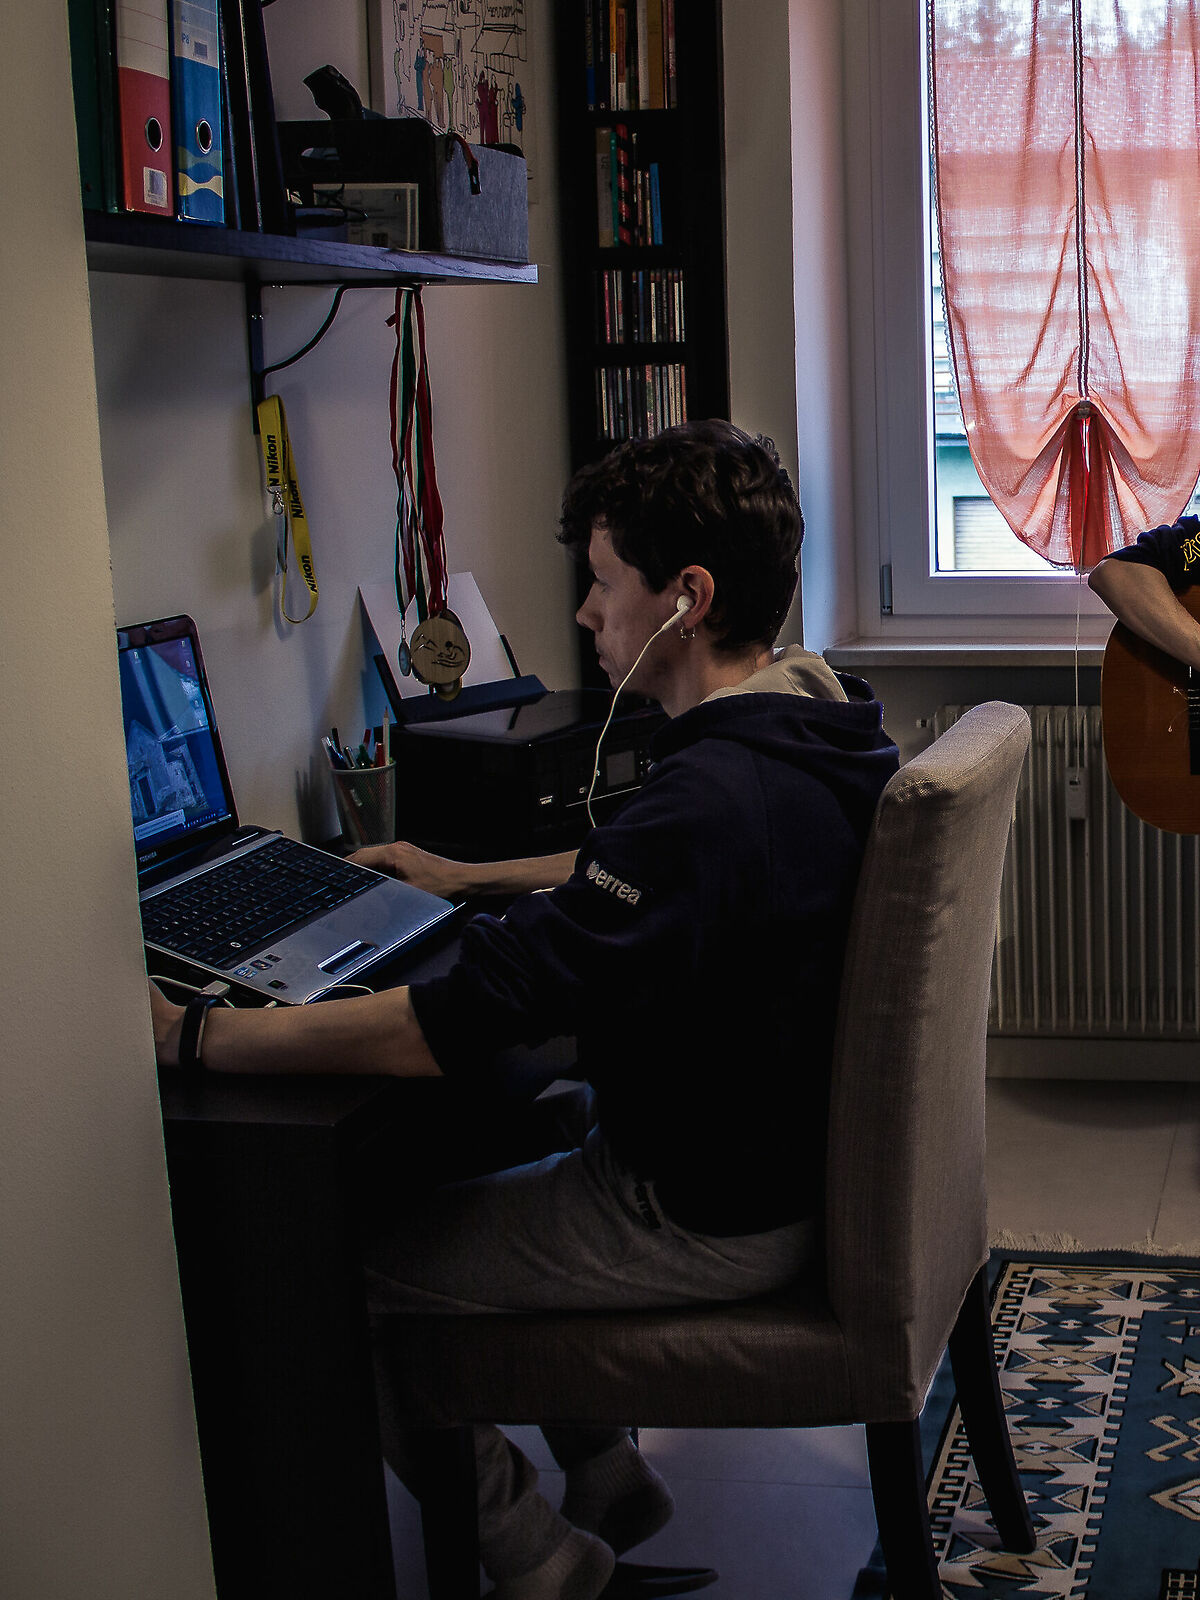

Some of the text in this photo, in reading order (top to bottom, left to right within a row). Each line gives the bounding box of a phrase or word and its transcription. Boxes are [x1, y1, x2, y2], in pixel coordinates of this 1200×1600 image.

[266, 434, 279, 474] Nikon
[289, 480, 304, 519] Nikon
[301, 555, 317, 593] Nikon
